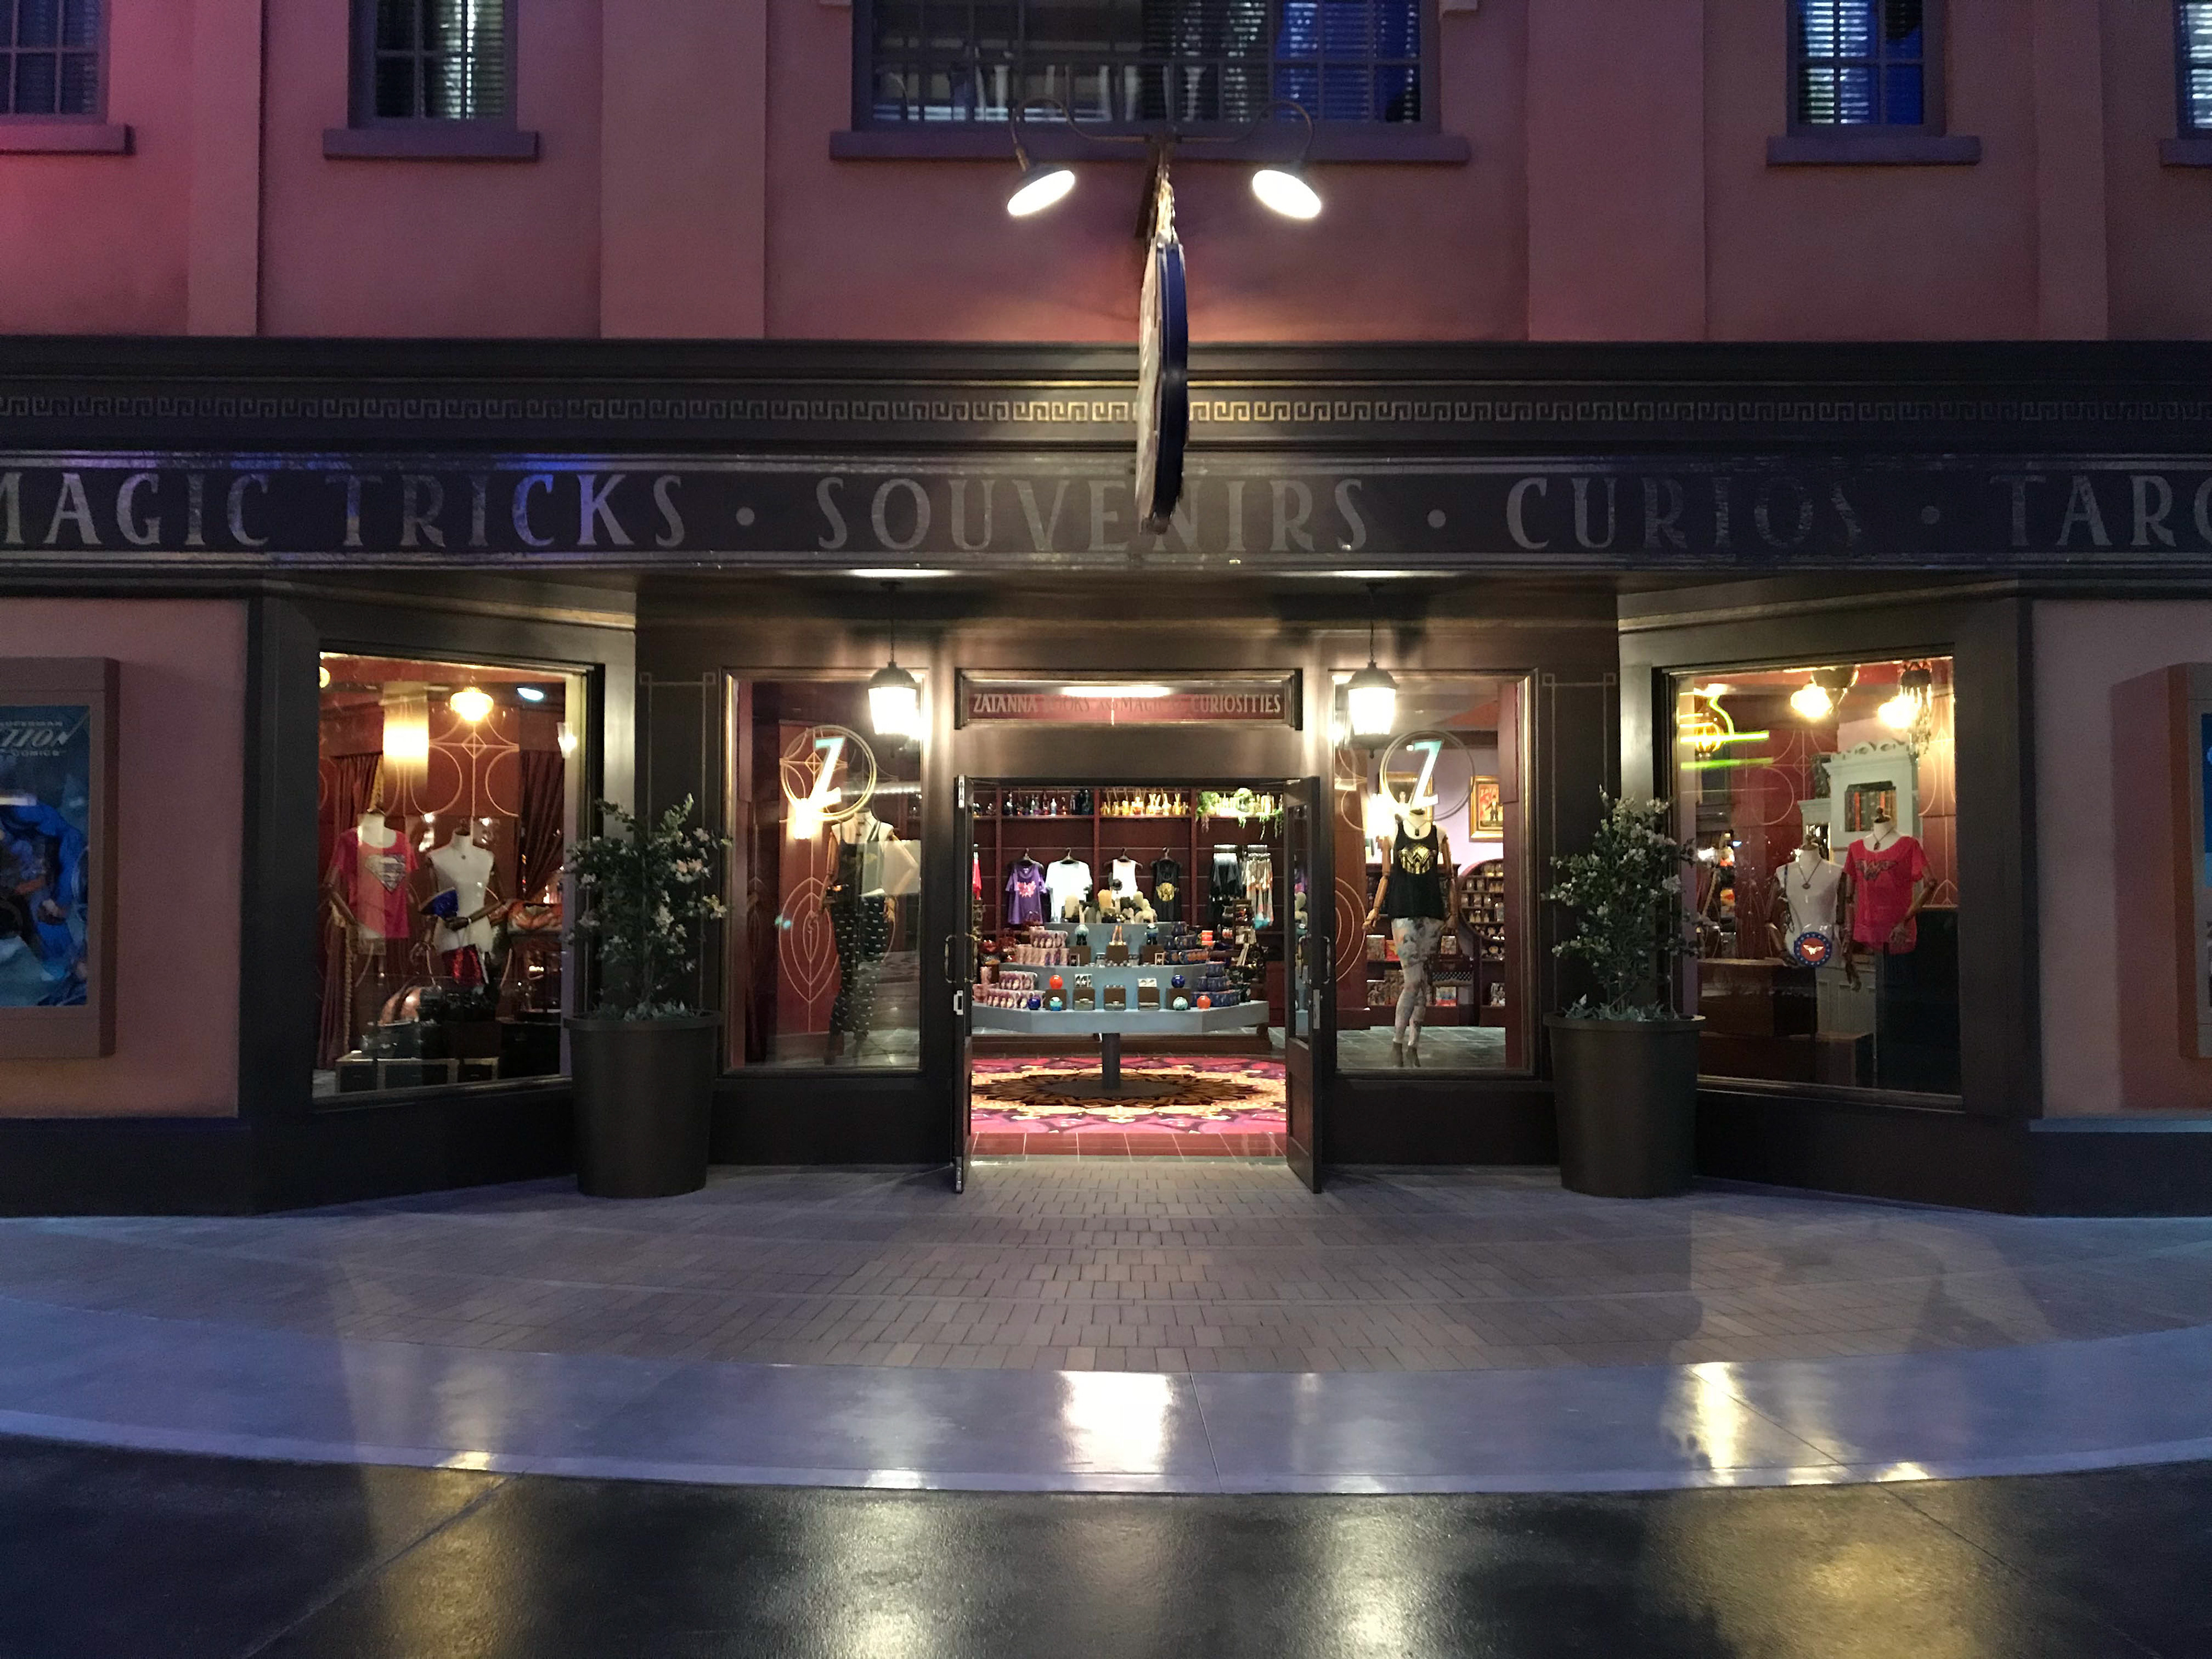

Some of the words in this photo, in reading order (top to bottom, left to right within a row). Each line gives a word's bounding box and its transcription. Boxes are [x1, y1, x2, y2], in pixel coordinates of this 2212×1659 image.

[324, 473, 687, 548] TRICKS
[816, 476, 1367, 552] SOUVENIRS
[1506, 476, 1862, 551] CURIOS
[973, 693, 1038, 713] ZATANNA
[1193, 694, 1281, 713] CURIOSITIES
